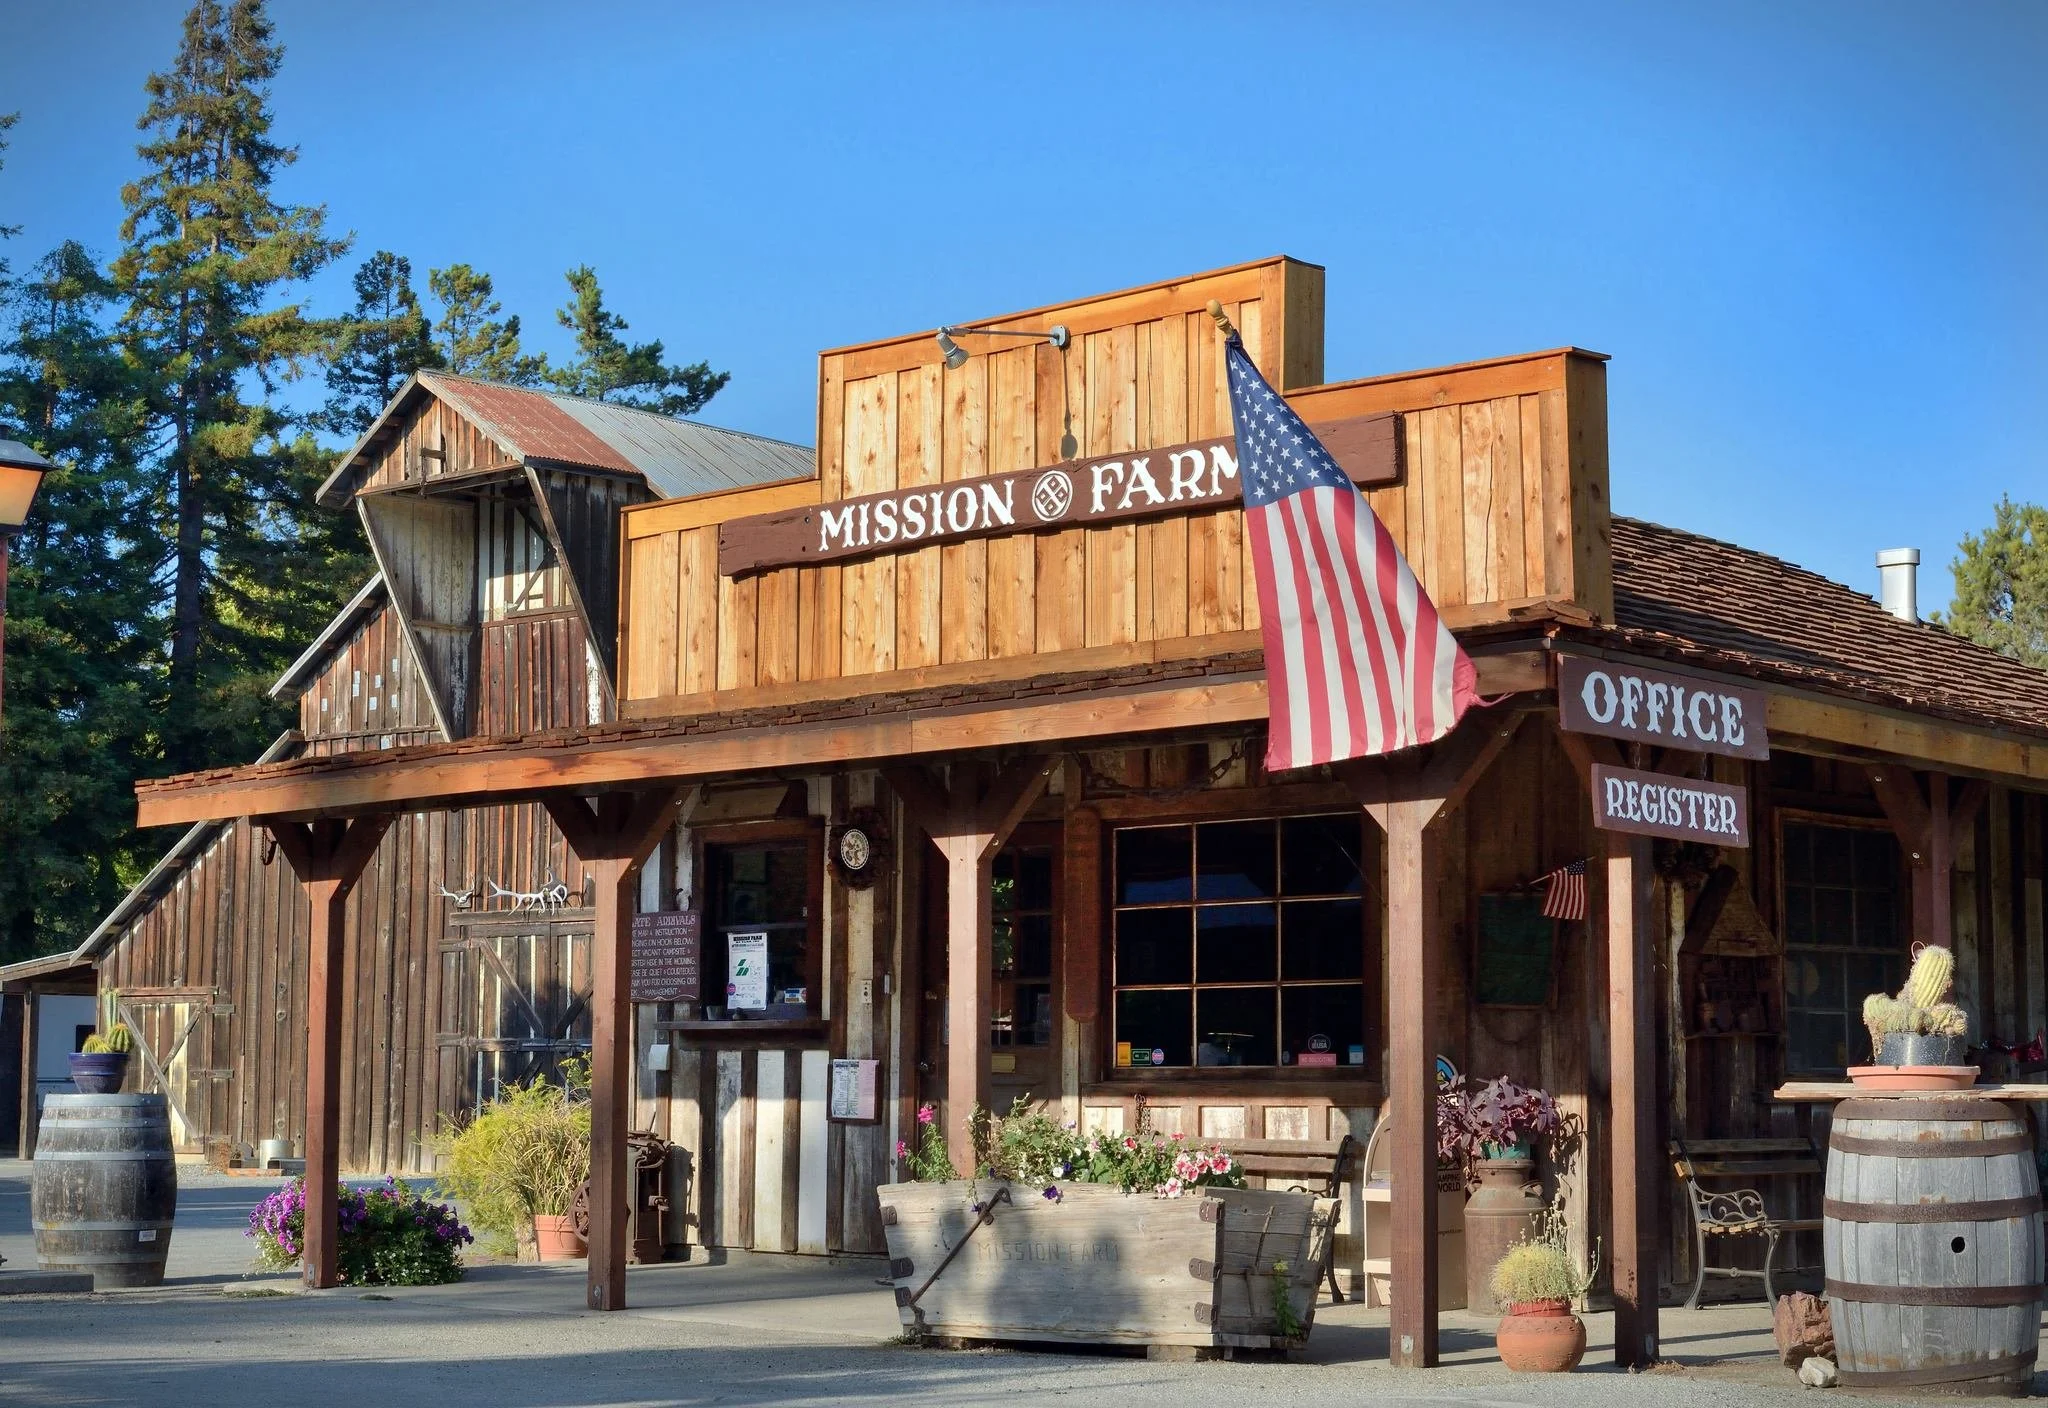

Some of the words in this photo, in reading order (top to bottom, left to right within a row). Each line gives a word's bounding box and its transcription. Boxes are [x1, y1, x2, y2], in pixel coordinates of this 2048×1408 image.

[817, 480, 1015, 551] MISSION
[1089, 445, 1239, 513] FARM
[1581, 671, 1745, 746] OFFICE
[1604, 777, 1739, 836] REGISTER
[656, 914, 696, 927] ARRIVALS
[632, 940, 649, 948] NGING
[662, 947, 686, 957] CAMPSITE
[1437, 1173, 1461, 1182] AMPING
[976, 1240, 1060, 1262] MISSION
